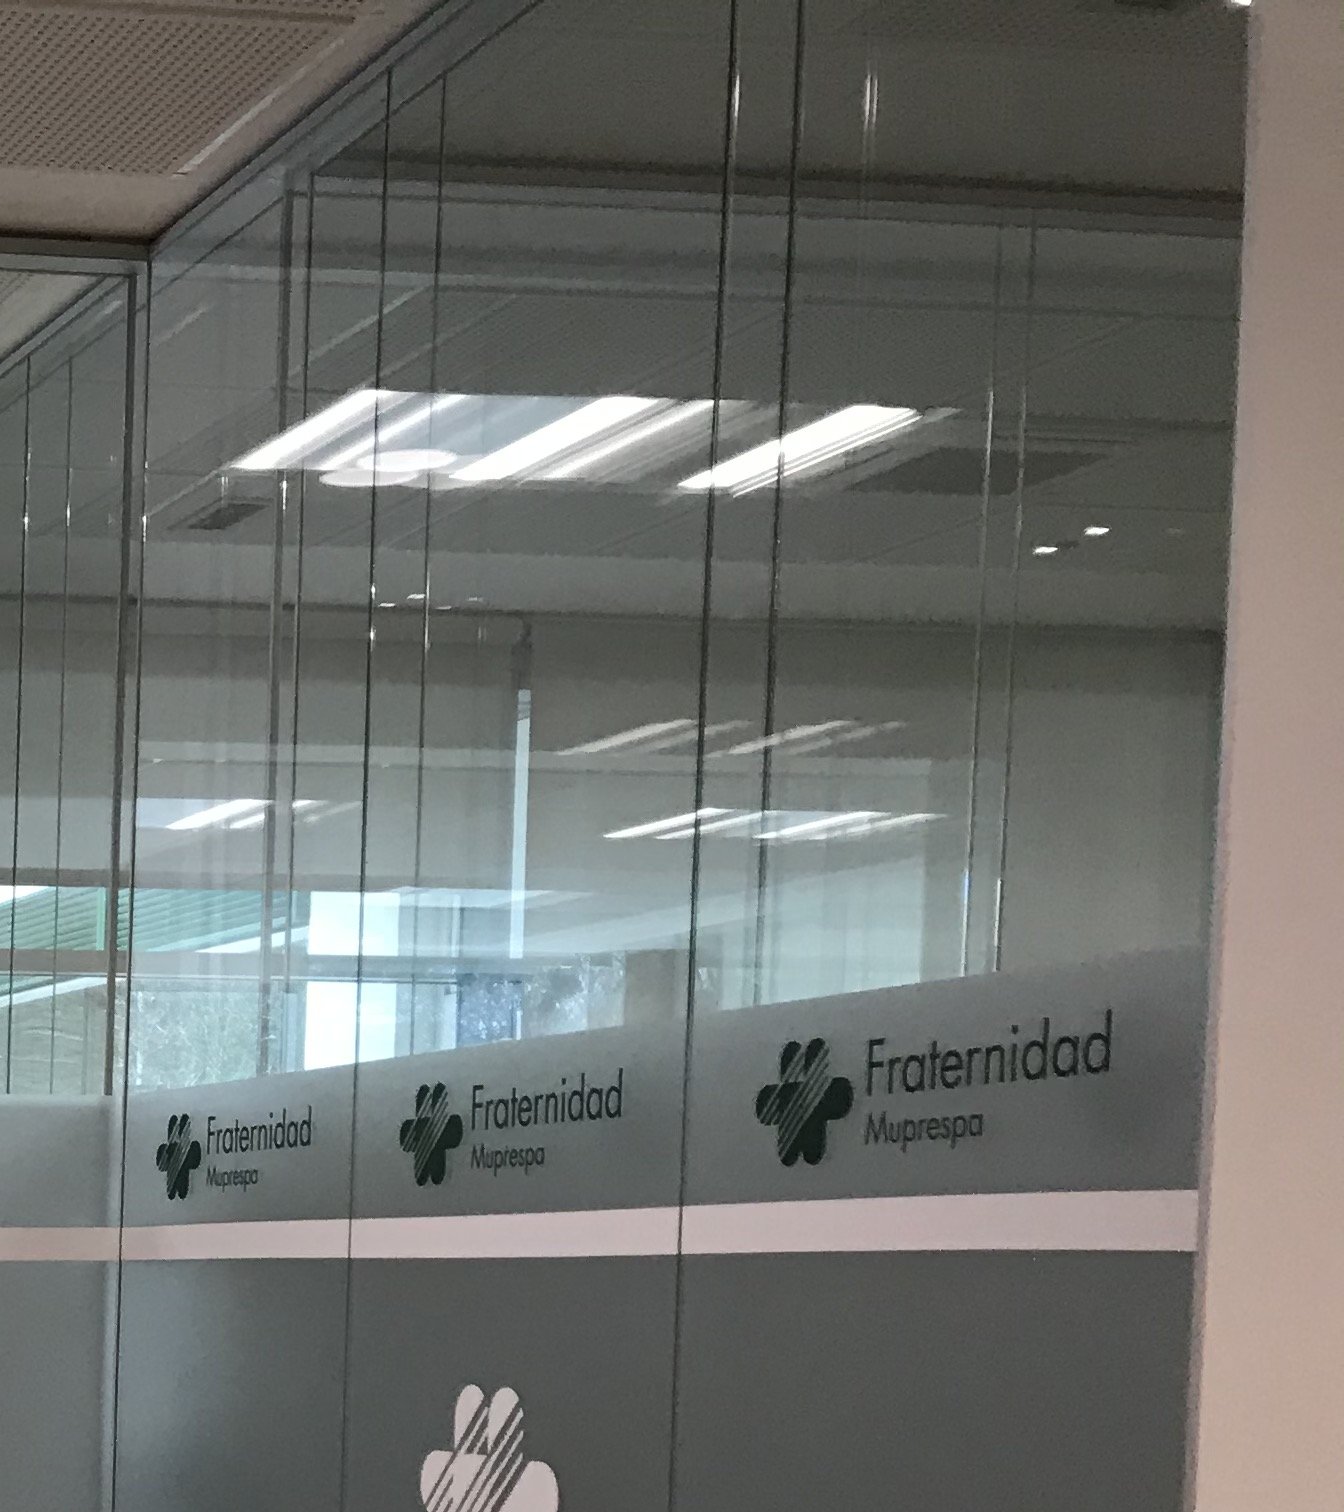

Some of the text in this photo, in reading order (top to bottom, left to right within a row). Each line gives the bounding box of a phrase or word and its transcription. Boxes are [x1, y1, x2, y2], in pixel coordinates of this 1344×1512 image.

[866, 1010, 1111, 1096] Fraternidad
[471, 1068, 622, 1131] Fraternidad
[206, 1105, 312, 1156] Fraternidad
[864, 1109, 984, 1154] Muprespa
[206, 1165, 260, 1191] Muprespa
[471, 1141, 546, 1175] Muprespa
